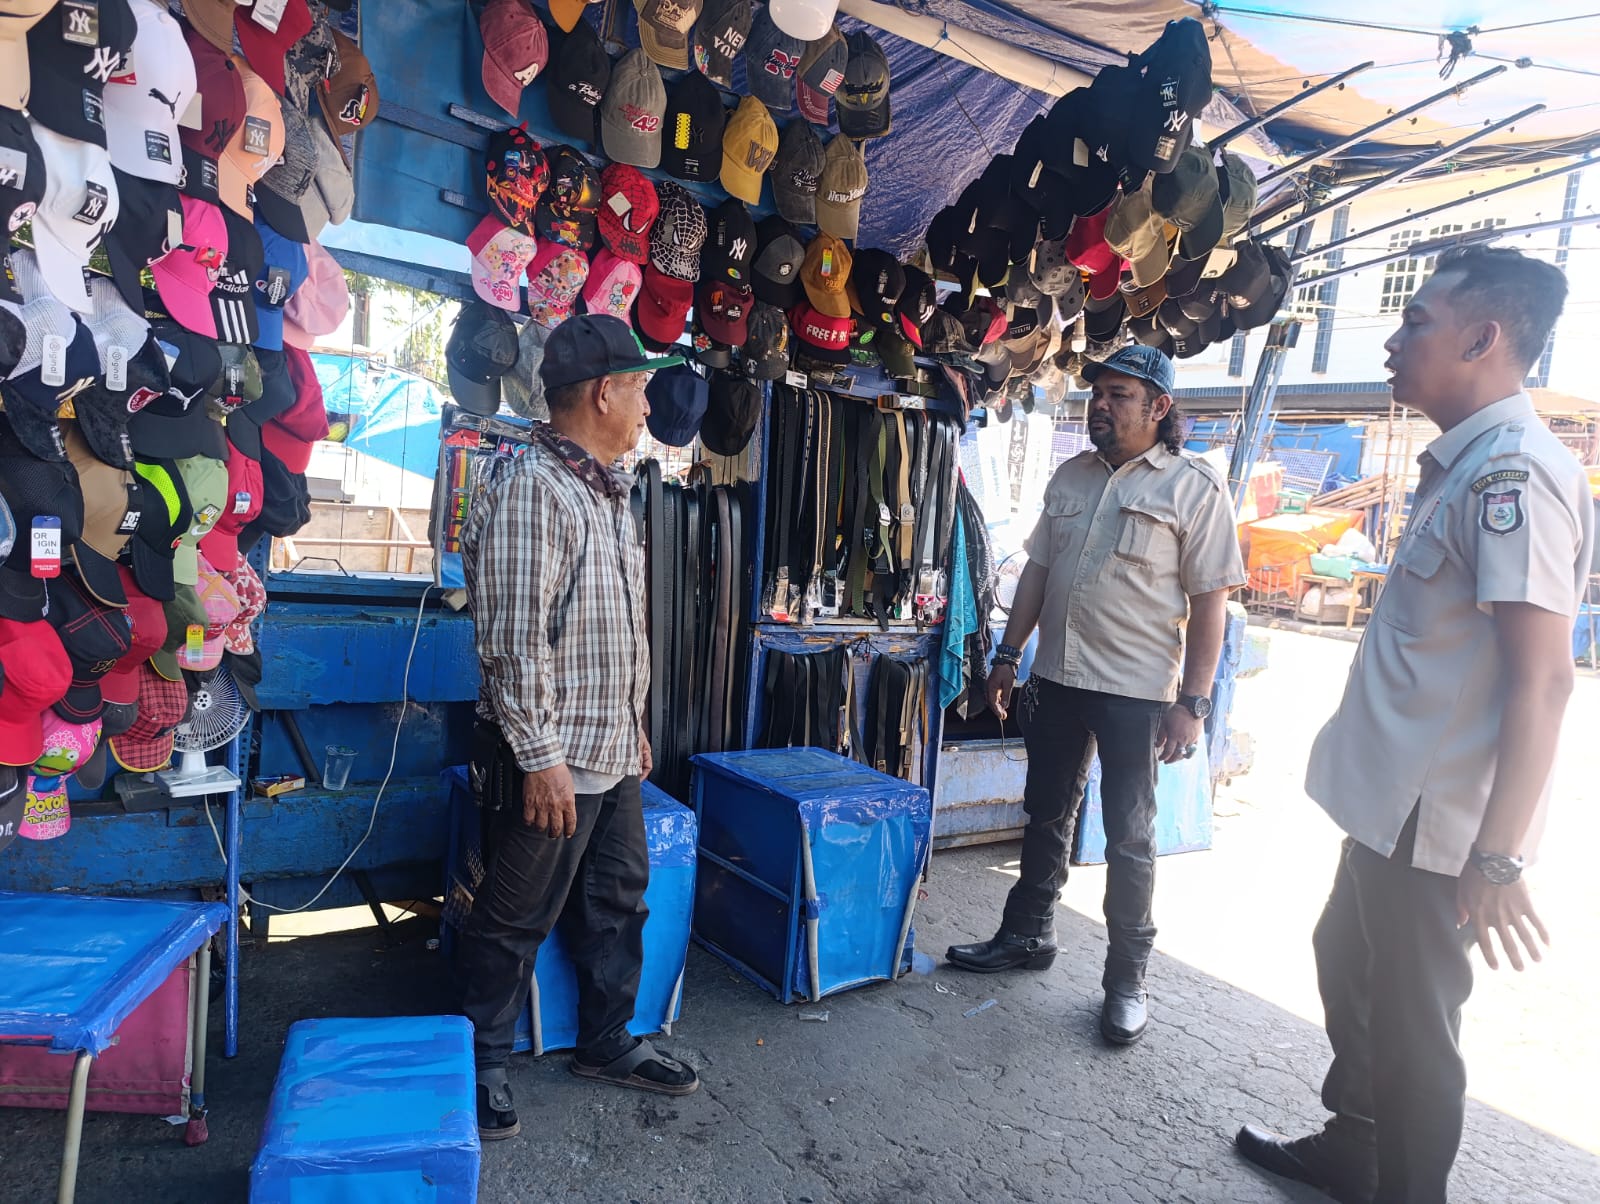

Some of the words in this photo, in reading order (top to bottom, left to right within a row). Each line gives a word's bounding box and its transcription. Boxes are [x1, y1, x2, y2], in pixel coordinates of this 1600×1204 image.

[632, 115, 660, 133] 42
[215, 281, 250, 293] adidas
[806, 324, 830, 341] FREE
[33, 532, 47, 540] OR
